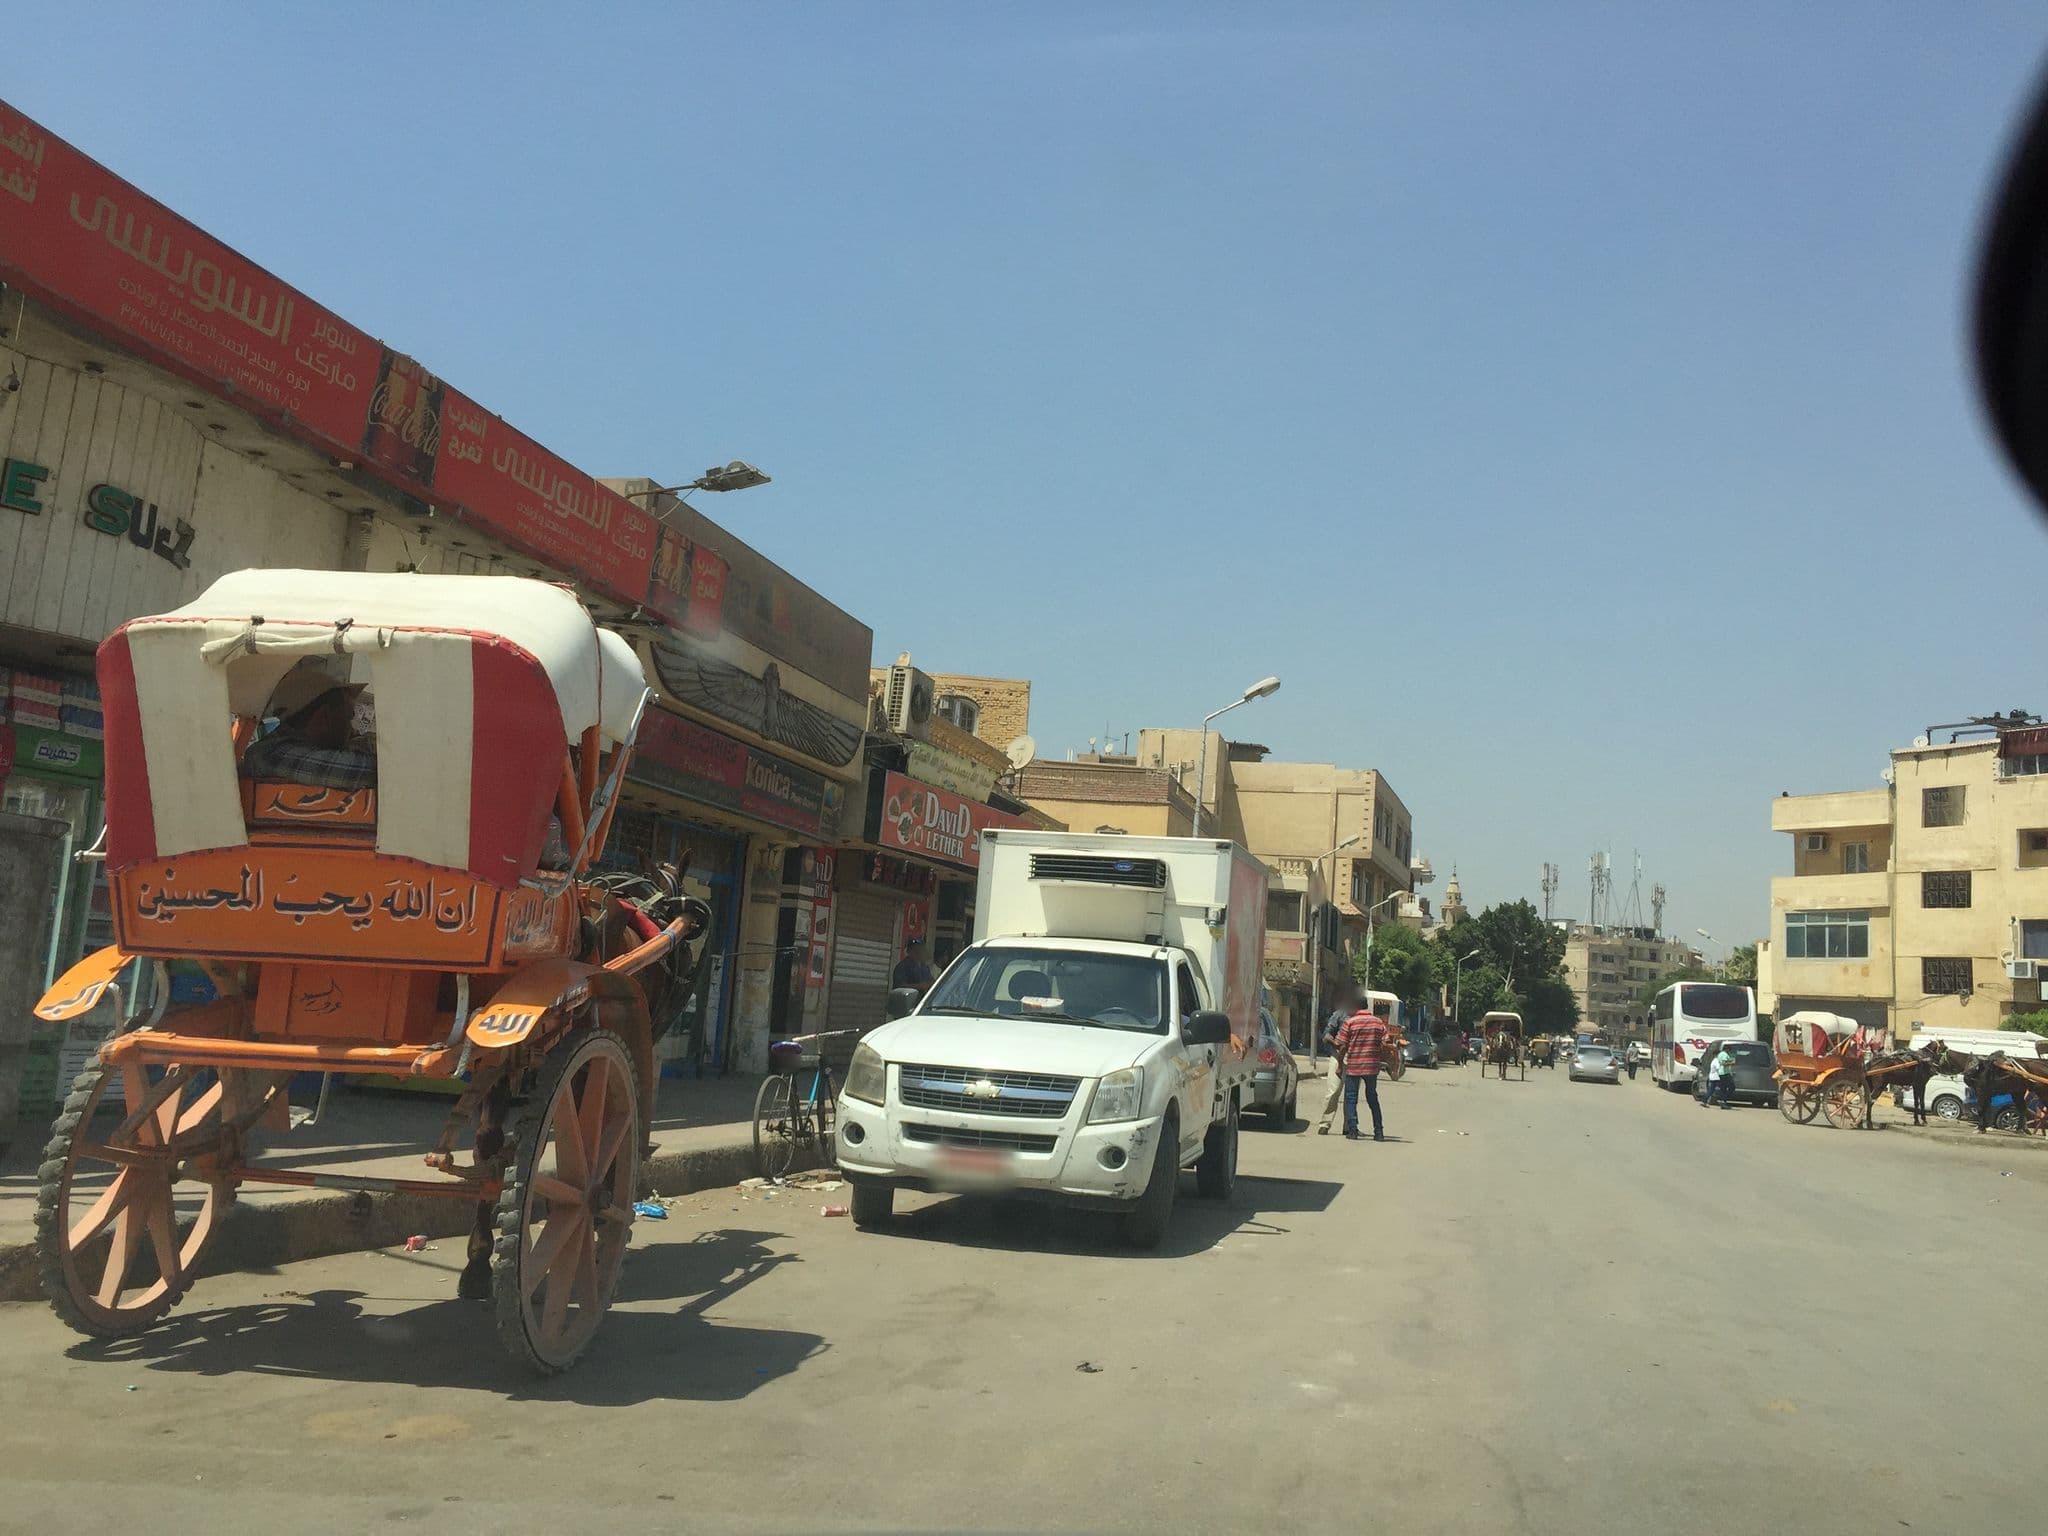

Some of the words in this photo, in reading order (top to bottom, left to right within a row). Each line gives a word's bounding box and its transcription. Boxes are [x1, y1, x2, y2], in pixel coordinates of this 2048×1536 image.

[310, 316, 358, 356] سوبر
[295, 344, 357, 393] ماركت
[925, 829, 965, 861] LETHER
[137, 863, 264, 924] المحسنين
[478, 1012, 537, 1034] الله
